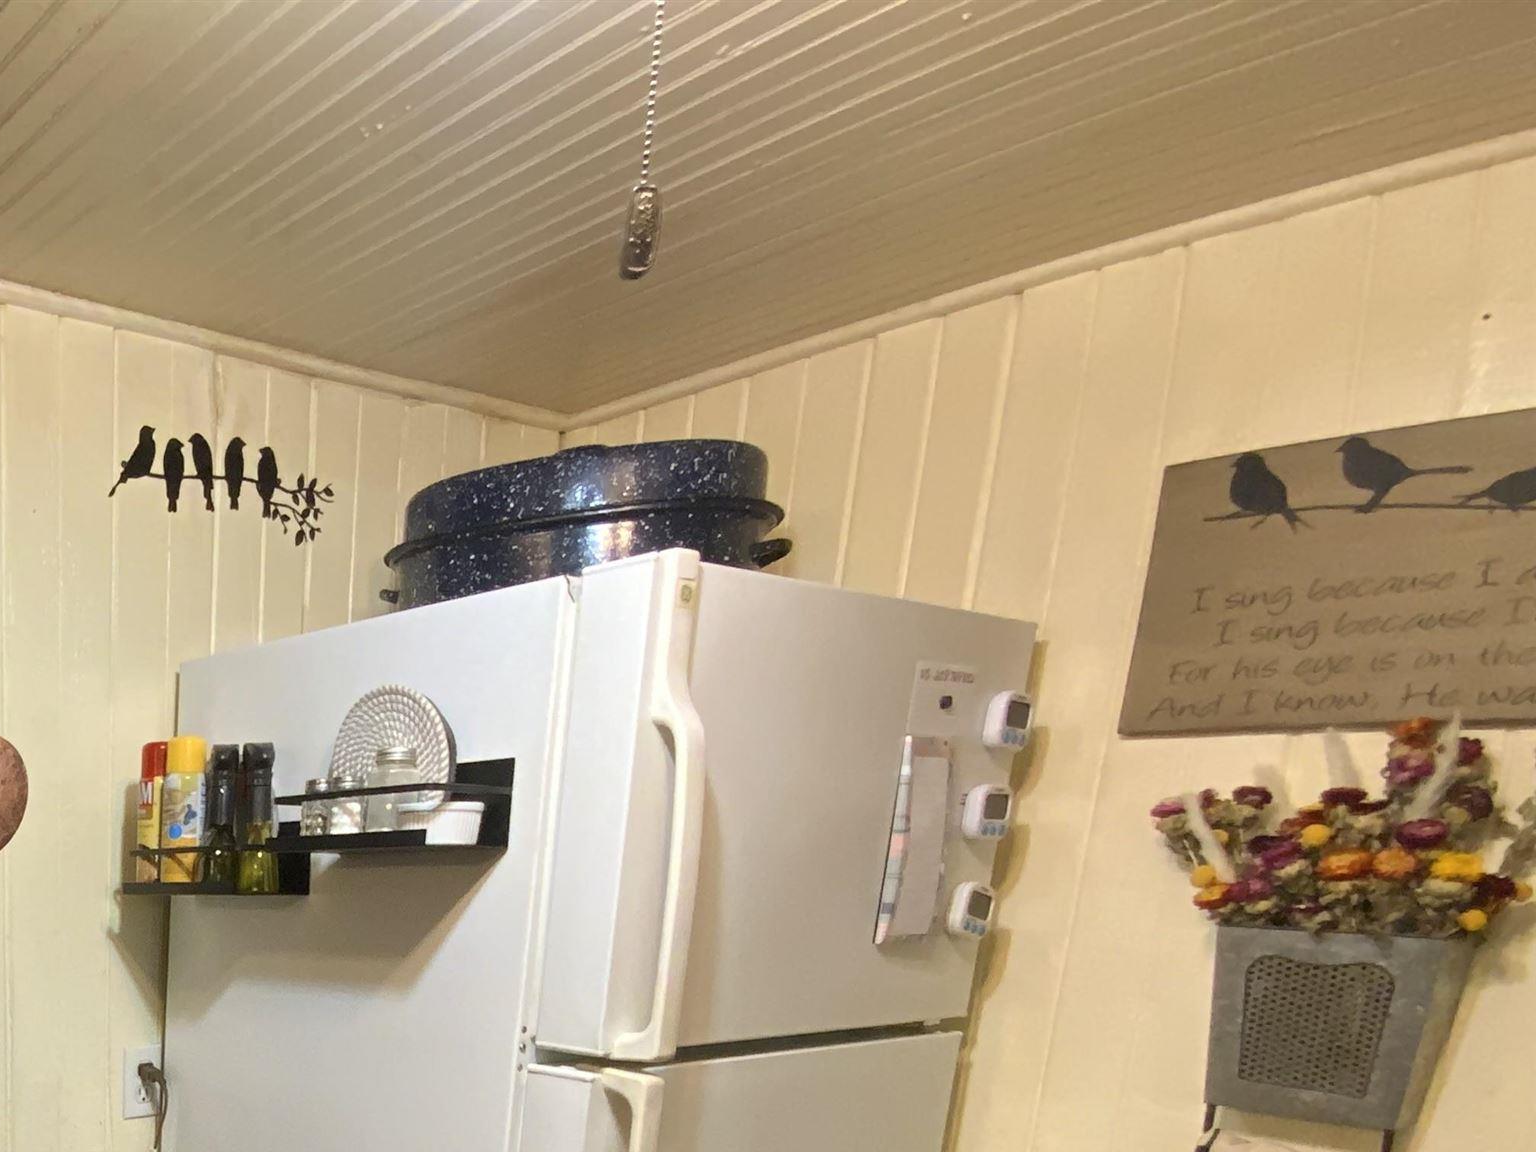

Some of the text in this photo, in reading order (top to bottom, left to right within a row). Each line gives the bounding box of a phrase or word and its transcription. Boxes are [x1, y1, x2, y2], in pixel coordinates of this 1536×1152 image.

[1189, 585, 1215, 614] I
[1225, 586, 1292, 616] sing
[1307, 571, 1456, 602] because
[1475, 557, 1504, 588] I
[1212, 619, 1237, 648] I
[1250, 620, 1318, 650] sing
[1334, 608, 1486, 637] because
[1168, 660, 1217, 685] For
[1232, 656, 1280, 680] his
[1293, 654, 1354, 686] eye
[1369, 652, 1398, 672] is
[1415, 652, 1456, 670] on
[1146, 693, 1226, 722] And
[1236, 689, 1260, 717] I
[1396, 683, 1463, 712] He
